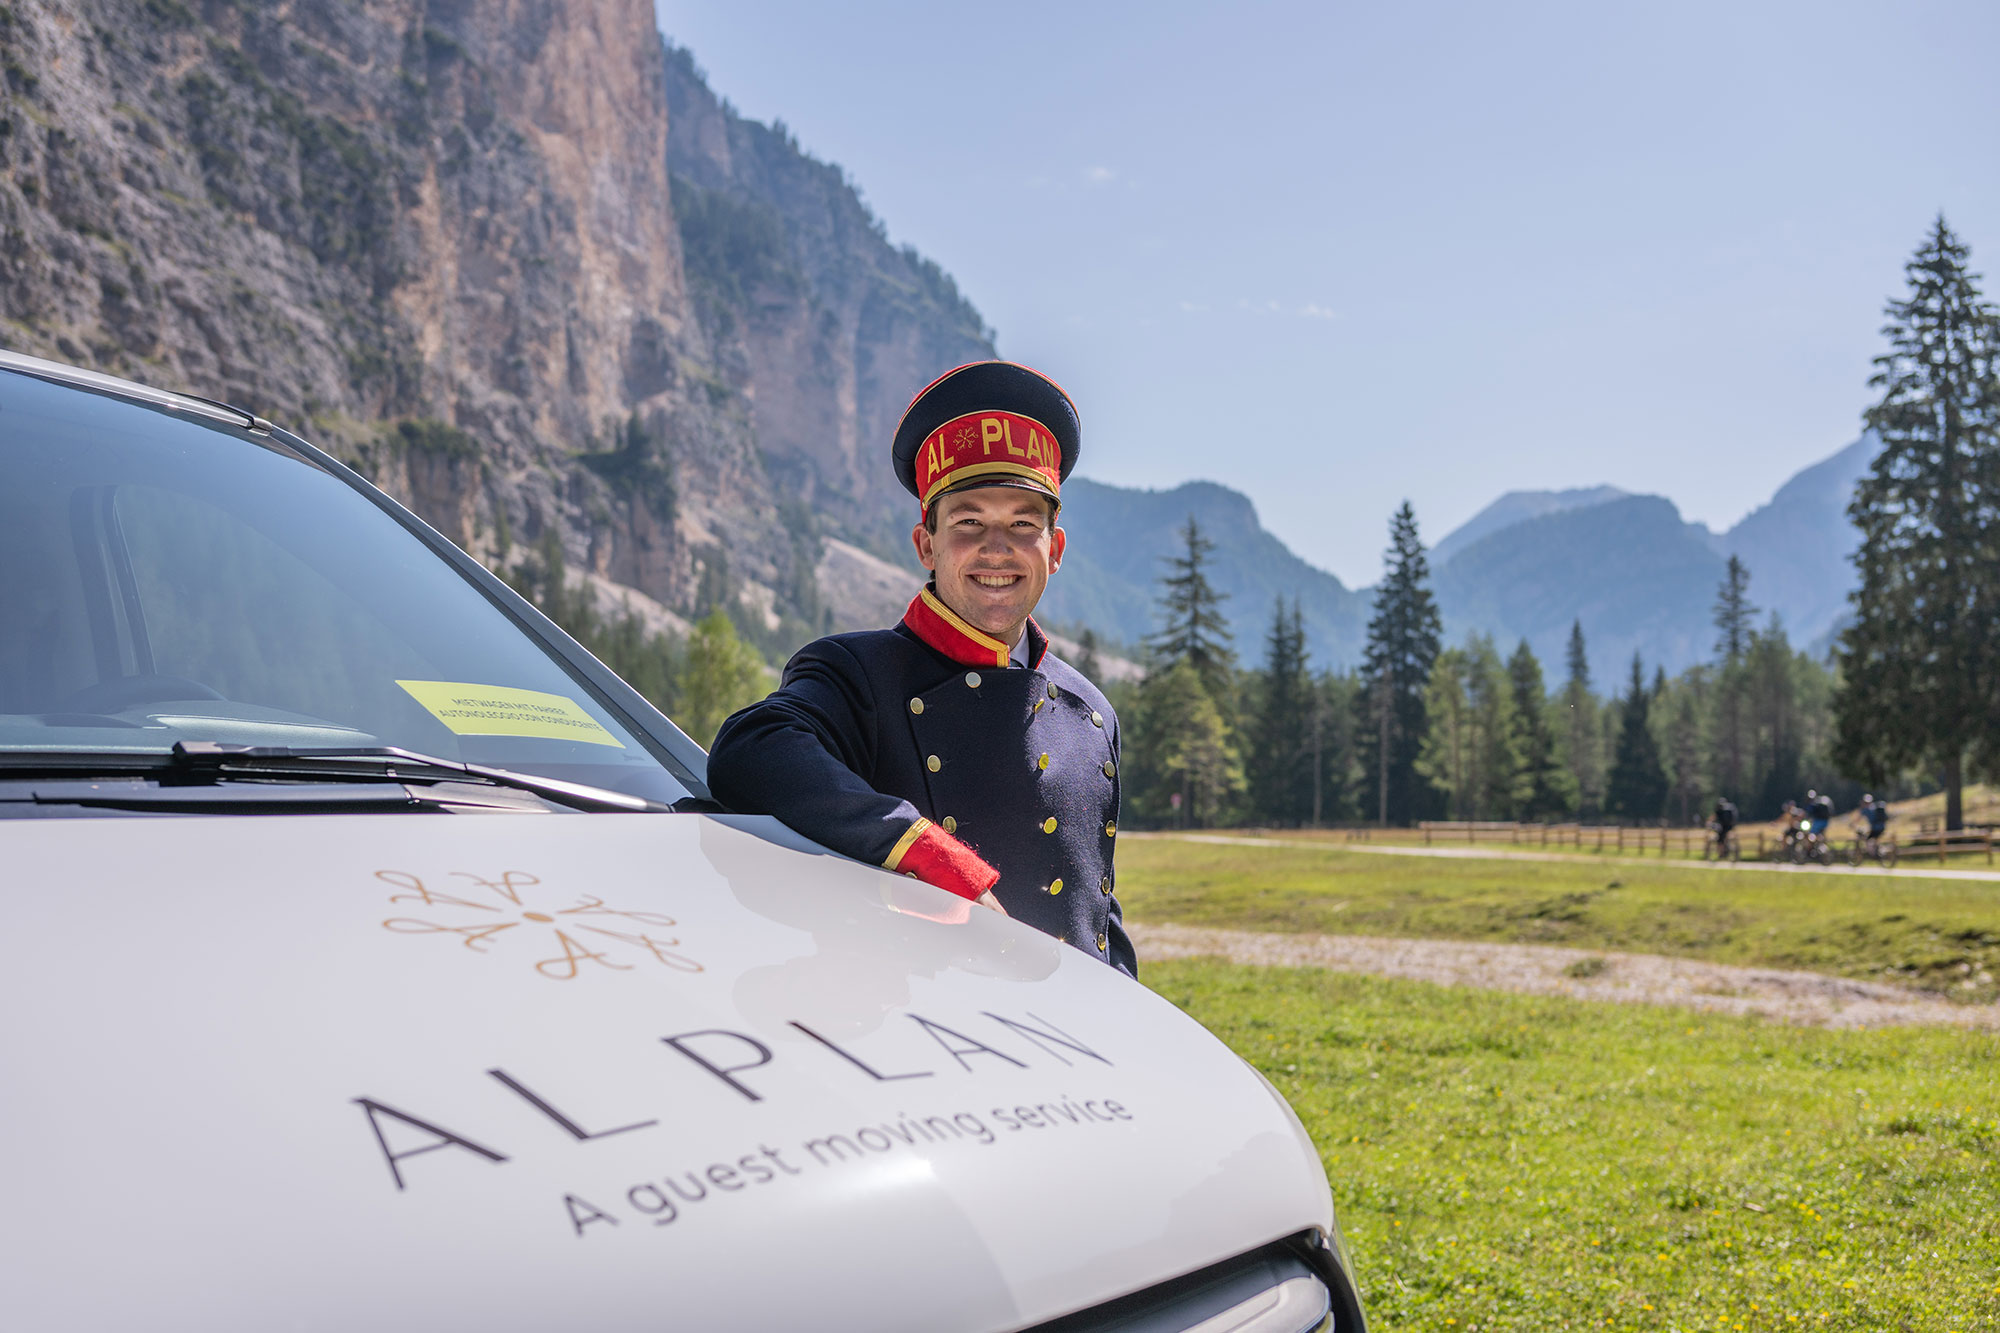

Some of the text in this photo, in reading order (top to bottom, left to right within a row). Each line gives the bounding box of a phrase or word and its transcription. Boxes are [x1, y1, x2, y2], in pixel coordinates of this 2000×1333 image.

[927, 418, 1055, 484] AL PLAN
[438, 709, 521, 721] AUTONOLEGGIO
[519, 712, 544, 722] CON
[451, 698, 516, 710] MIETWAGEN
[513, 703, 532, 712] MIT
[350, 1010, 1115, 1192] AL PLAN
[563, 1094, 1134, 1238] A guest moving service
